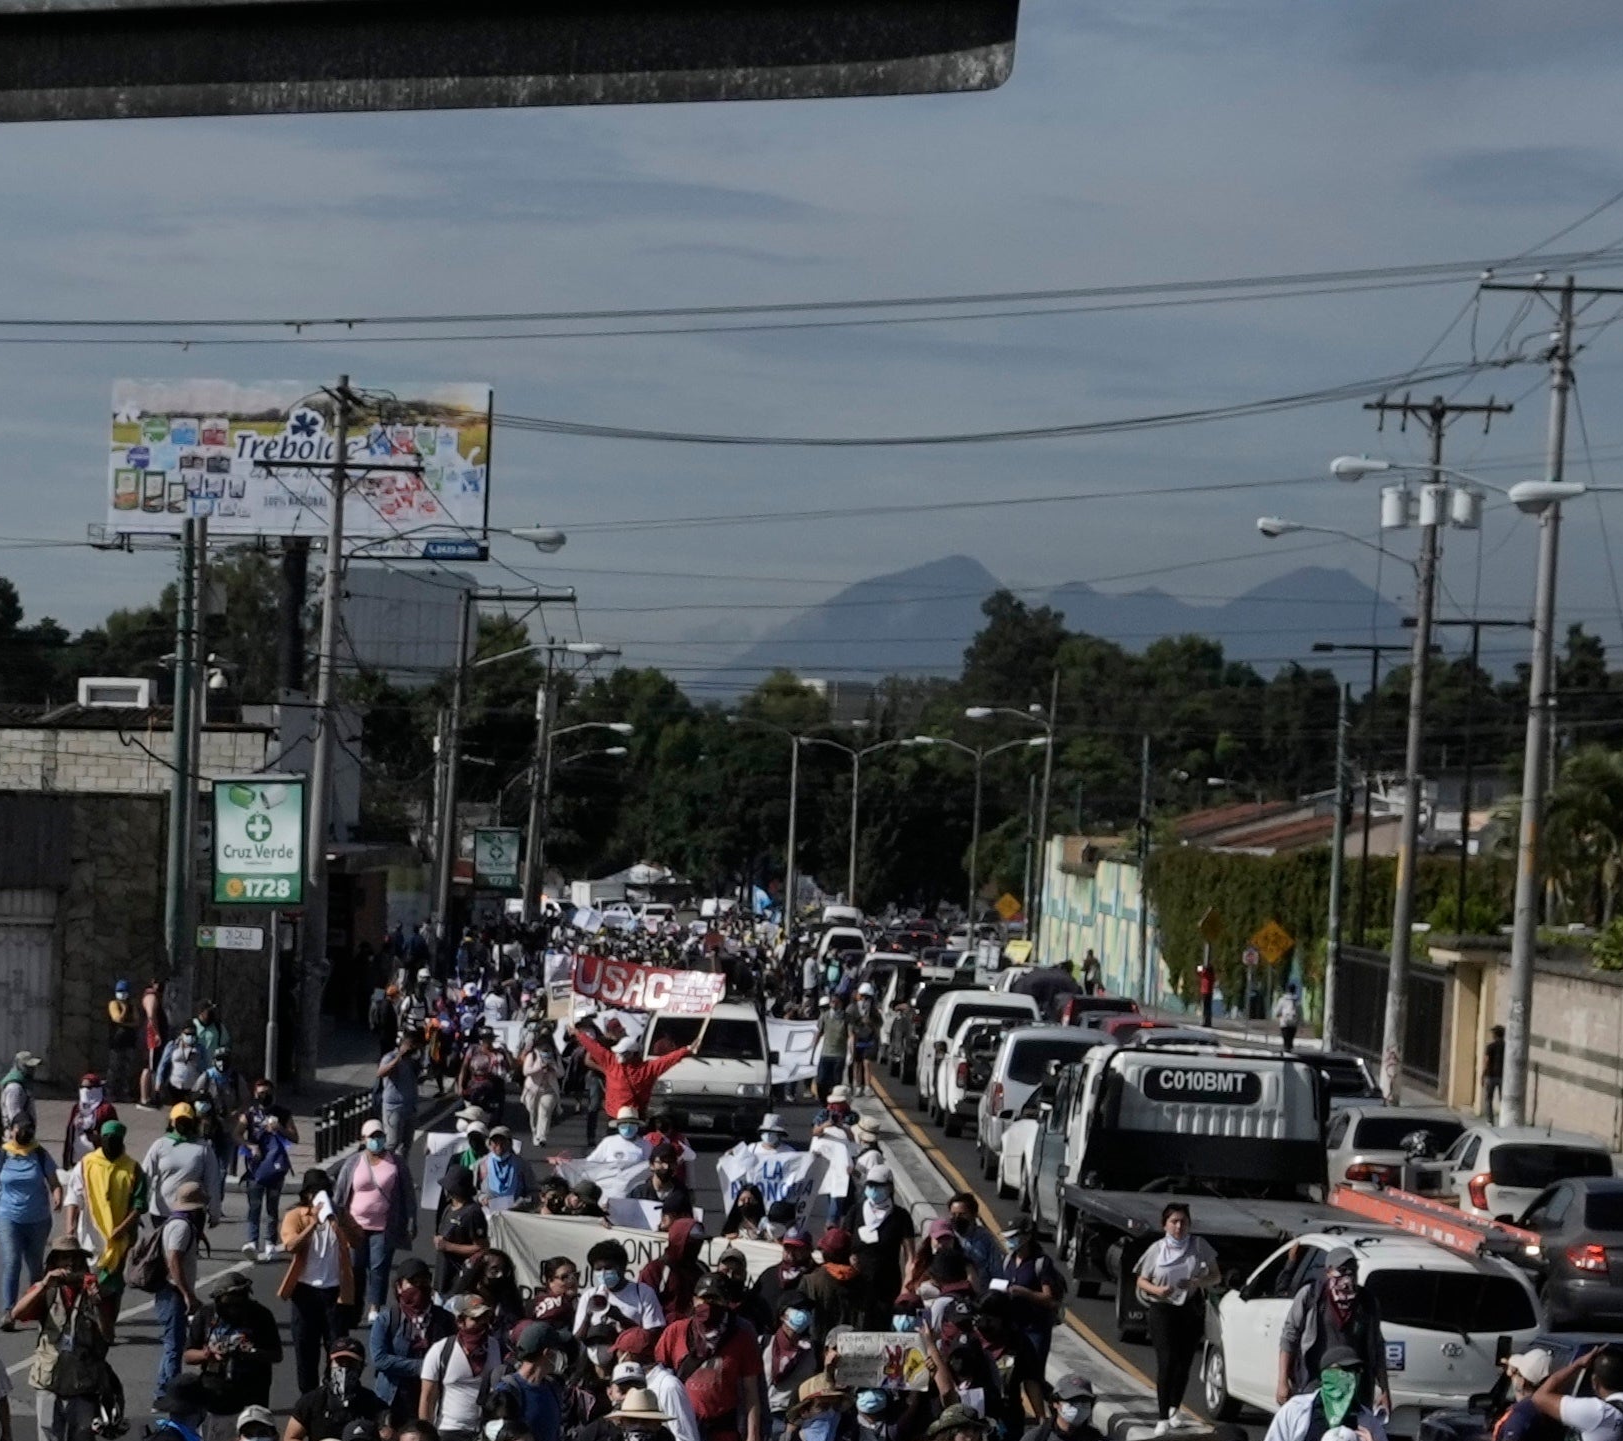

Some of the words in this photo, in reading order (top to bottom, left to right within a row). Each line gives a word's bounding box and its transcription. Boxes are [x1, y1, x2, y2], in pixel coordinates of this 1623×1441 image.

[223, 843, 252, 859] Cruz
[256, 844, 294, 860] Verde
[243, 878, 291, 898] 1728
[575, 956, 673, 1009] USAC
[1159, 1069, 1247, 1093] C010BMT
